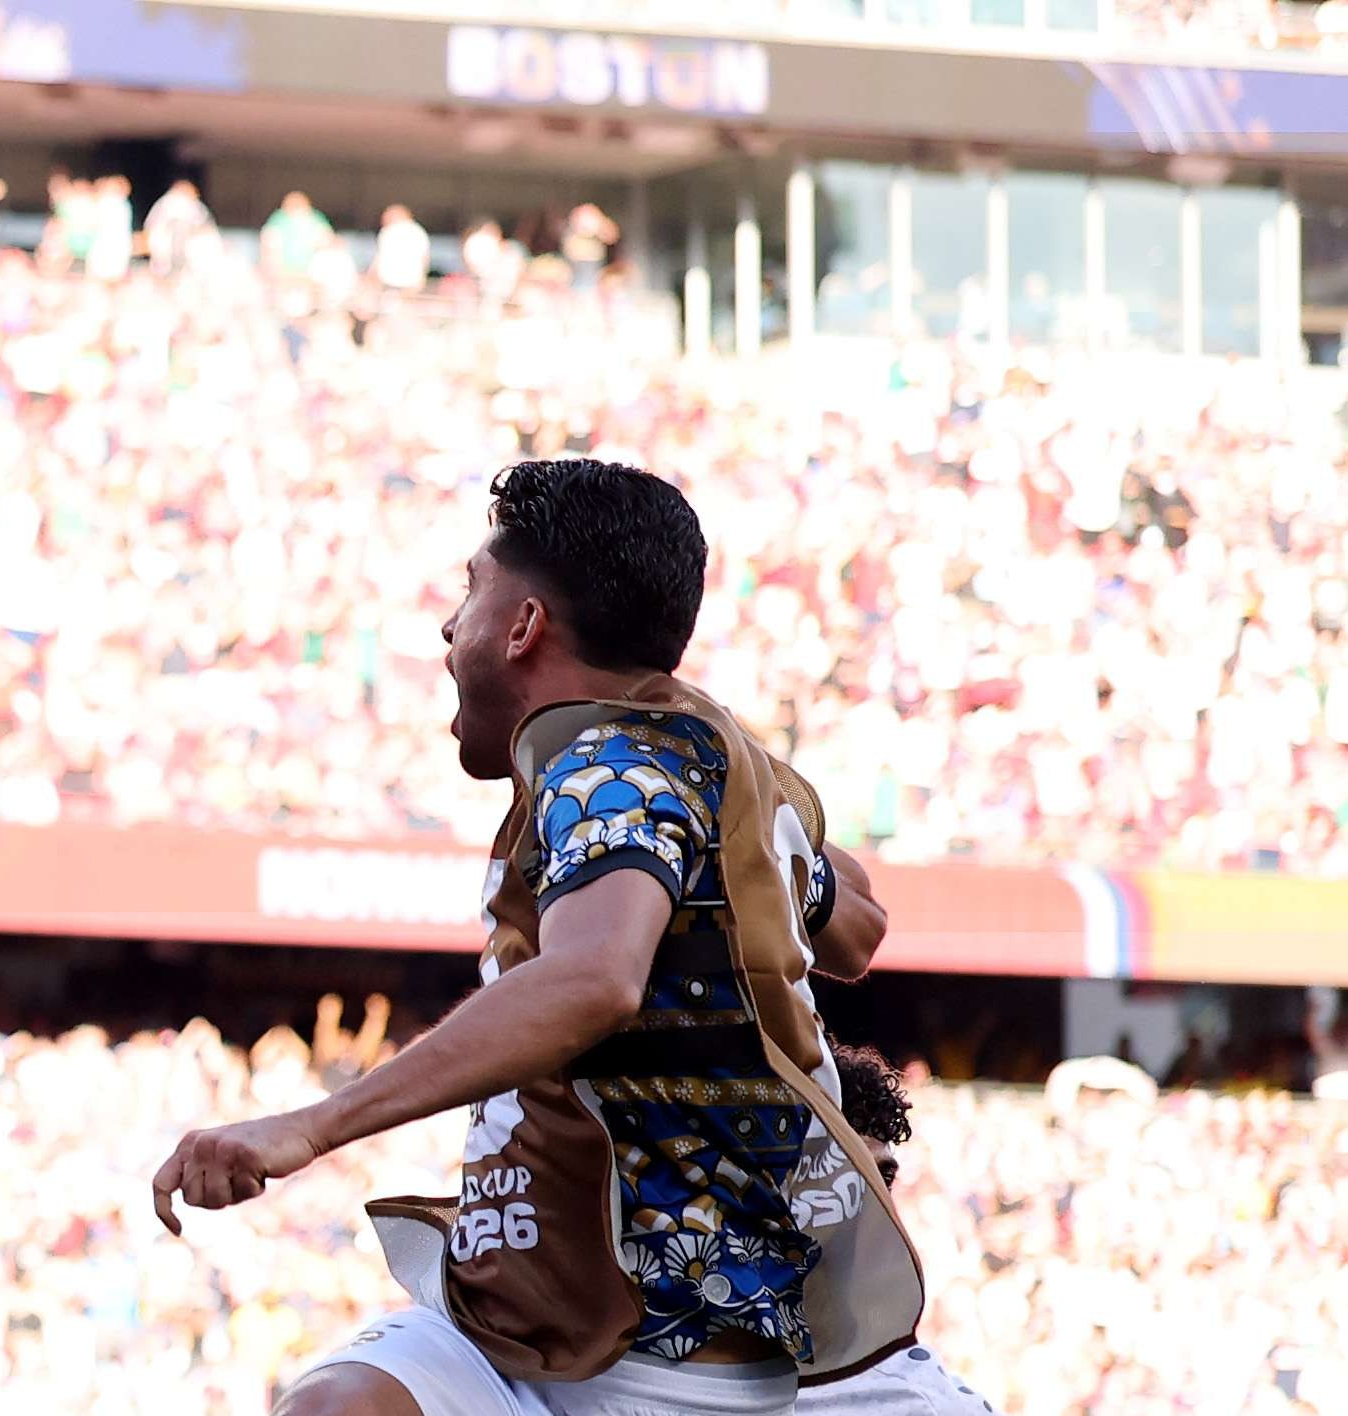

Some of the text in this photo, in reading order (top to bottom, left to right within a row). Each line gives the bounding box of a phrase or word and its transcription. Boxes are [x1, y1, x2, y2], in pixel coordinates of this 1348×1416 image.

[447, 24, 768, 115] BOSTON
[482, 1166, 532, 1200] CUP
[450, 1201, 539, 1262] 026
